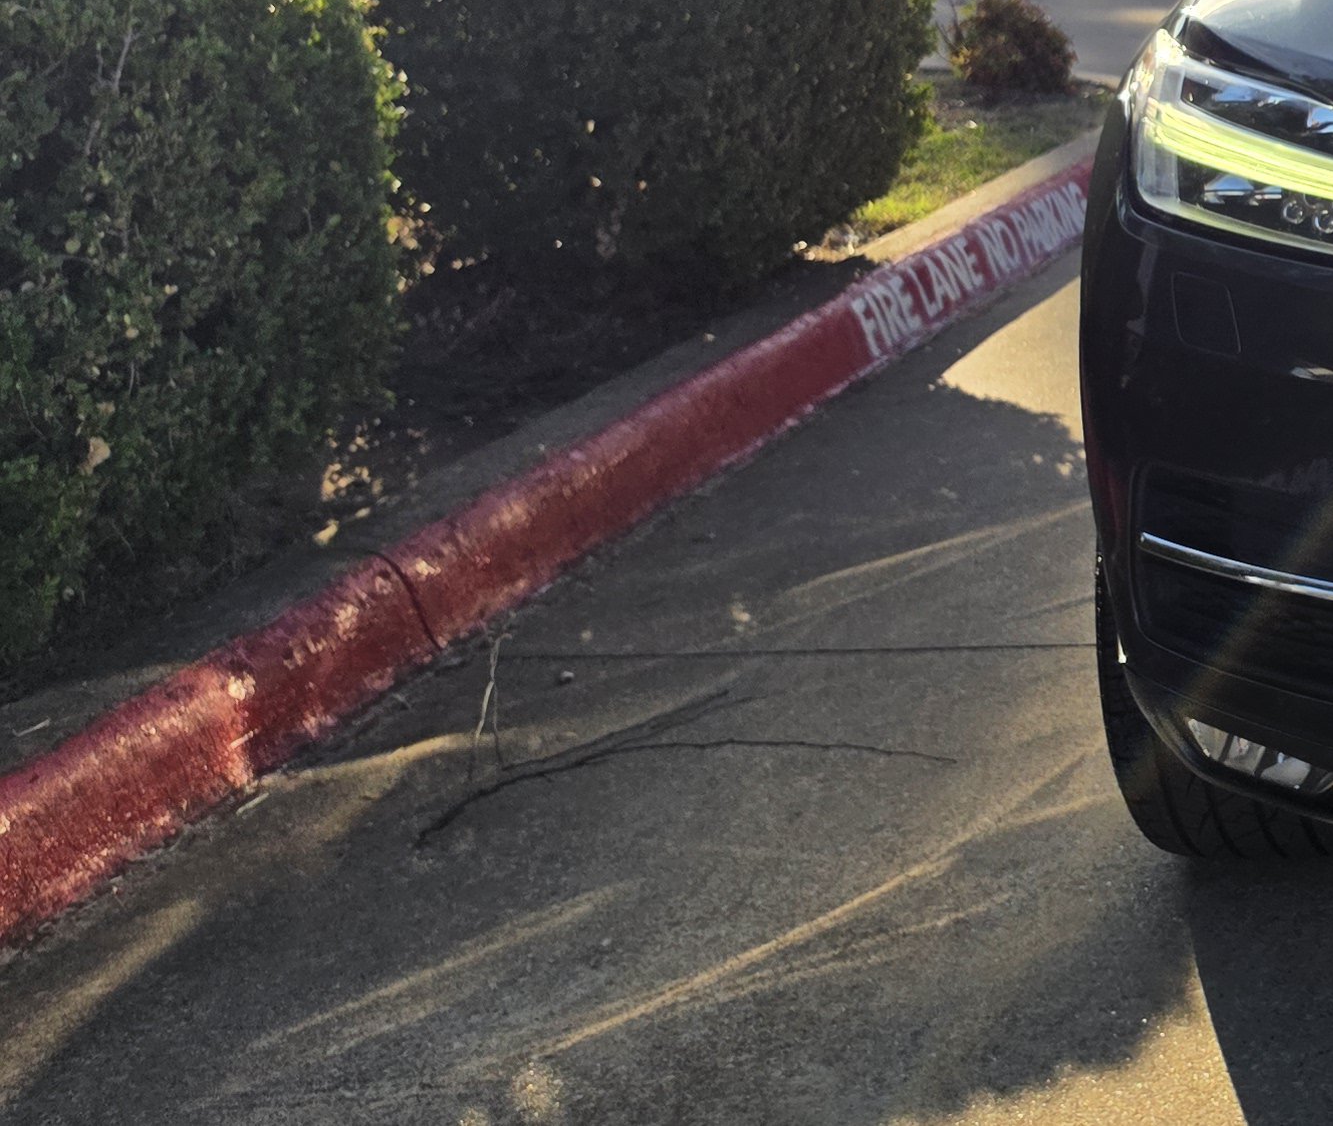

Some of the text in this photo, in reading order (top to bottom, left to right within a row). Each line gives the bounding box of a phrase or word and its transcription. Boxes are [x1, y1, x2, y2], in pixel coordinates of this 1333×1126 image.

[852, 276, 922, 358] FIRE
[907, 235, 984, 317] LANE
[975, 220, 1020, 277] NO
